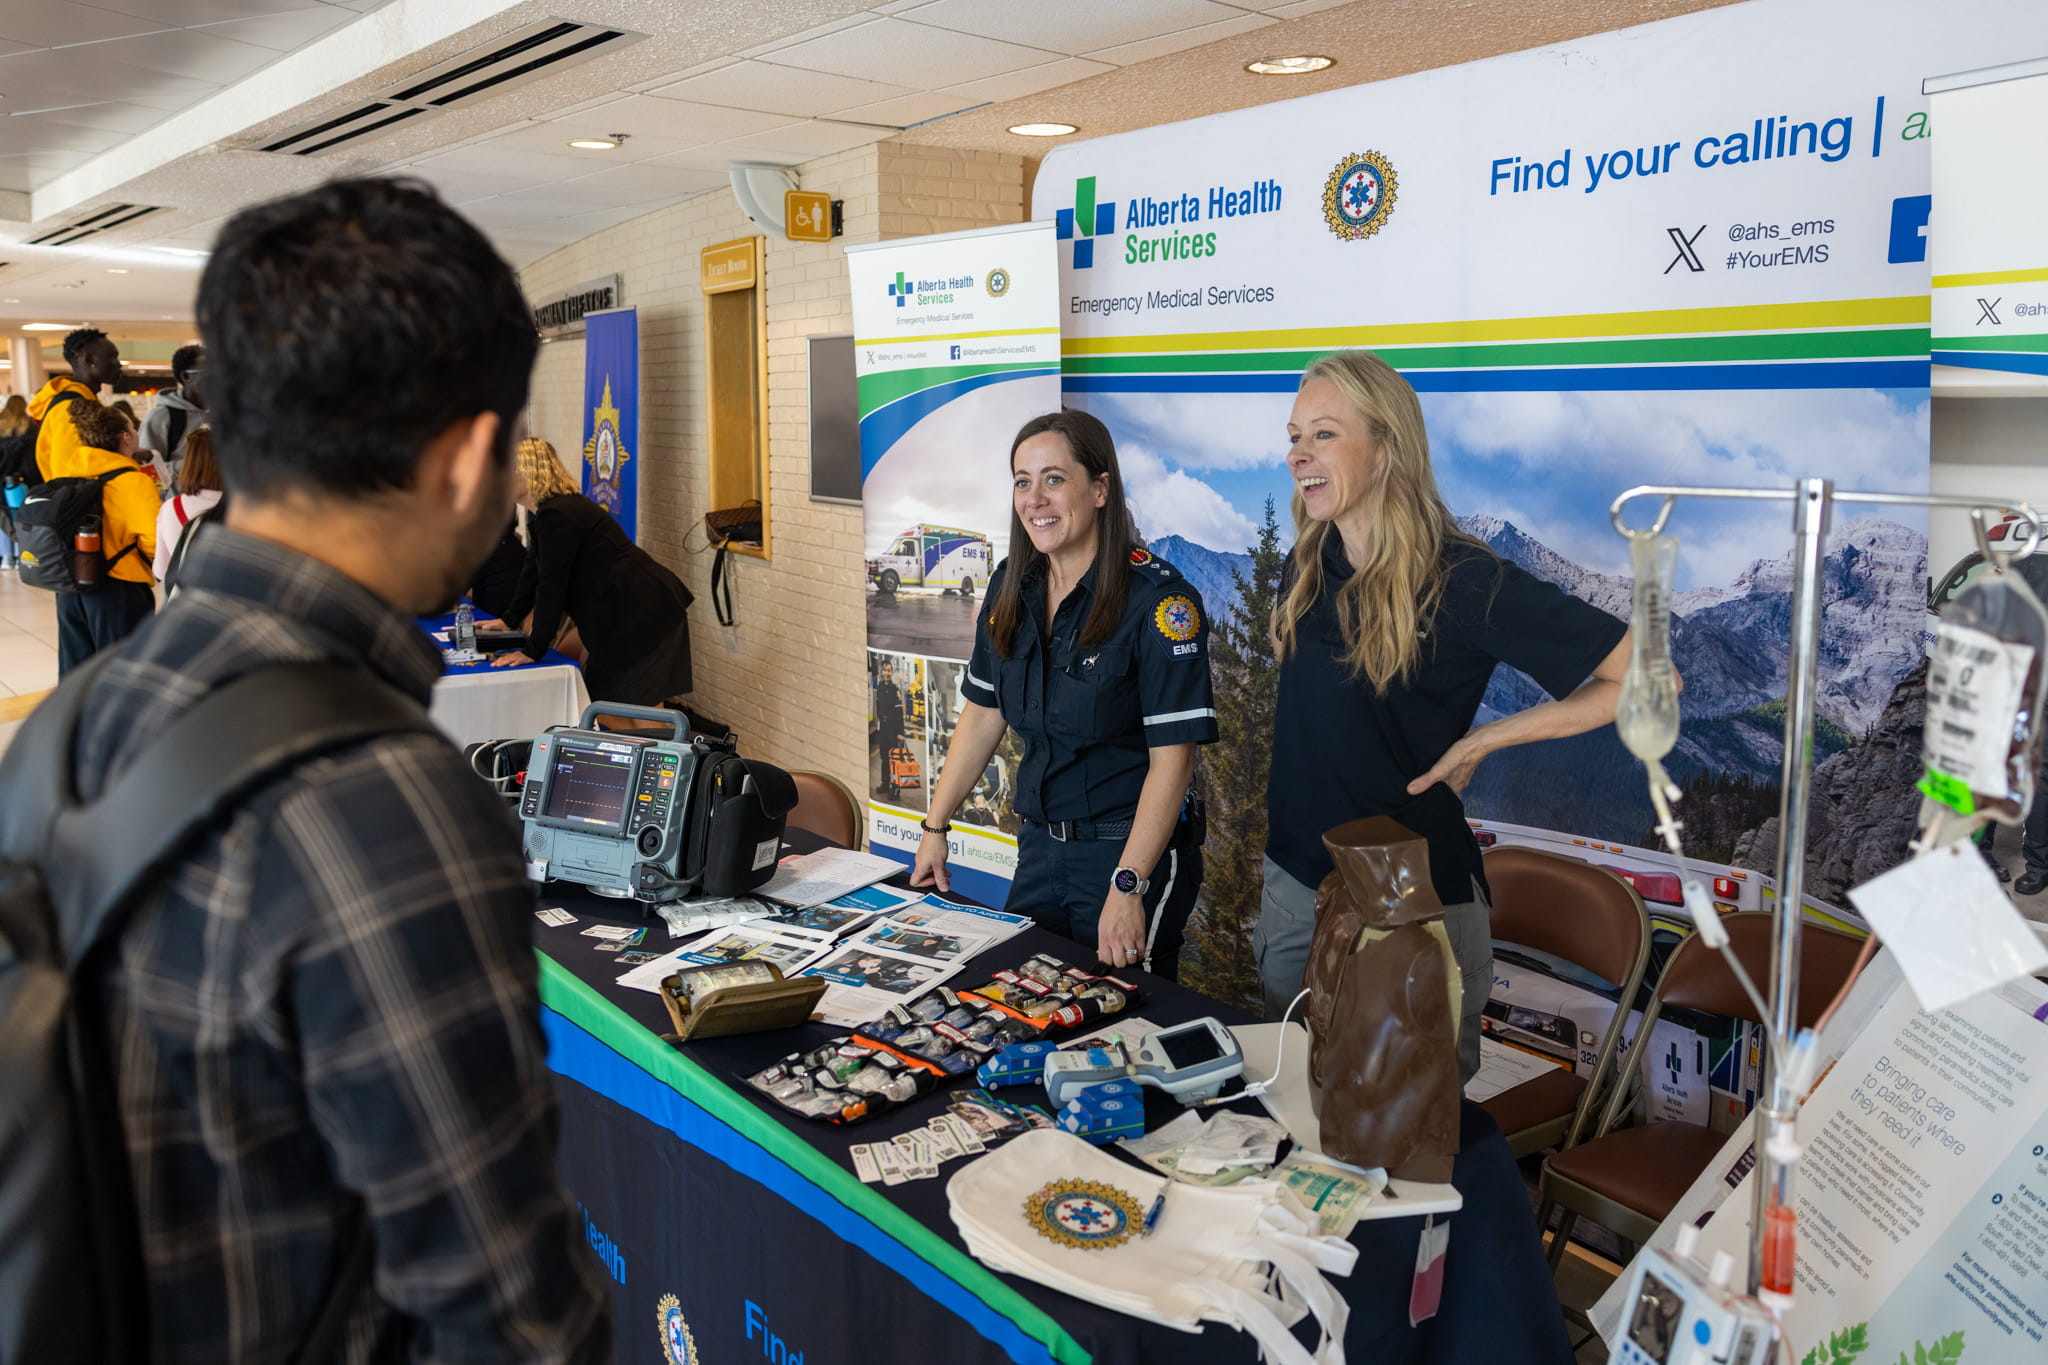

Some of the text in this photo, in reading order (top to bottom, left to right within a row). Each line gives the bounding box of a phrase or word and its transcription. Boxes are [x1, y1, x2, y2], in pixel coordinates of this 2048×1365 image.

[1490, 149, 1570, 196] Find
[1585, 141, 1681, 193] your
[1693, 114, 1853, 170] calling
[1126, 179, 1282, 229] Alberta Health
[1125, 231, 1216, 265] Services
[1728, 218, 1835, 242] @ahs_ems
[1726, 244, 1829, 270] #YourEMS
[917, 275, 974, 292] Alberta Health
[917, 293, 954, 306] Services
[1071, 285, 1274, 316] Emergency Medical Services
[962, 547, 977, 559] EMS
[1173, 643, 1198, 656] EMS
[877, 820, 897, 836] Find
[900, 830, 922, 841] your
[939, 903, 963, 911] HOW
[977, 911, 1009, 921] APPLY
[1892, 1037, 1903, 1047] to
[1899, 1042, 1931, 1068] patients
[1929, 1062, 1938, 1071] in
[1936, 1067, 1954, 1083] their
[1900, 1026, 1939, 1058] community
[1938, 1052, 1981, 1085] paramedics
[1977, 1079, 1999, 1099] bring
[1908, 1016, 1929, 1035] signs
[1927, 1029, 1944, 1044] and
[1941, 1038, 1977, 1066] providing
[1950, 1028, 1970, 1044] tests
[1968, 1040, 1978, 1050] to
[1871, 1054, 1957, 1123] Bringing care
[1847, 1087, 1923, 1148] they need it
[1861, 1071, 1968, 1157] to patients where
[1819, 1126, 1845, 1150] receiving
[1843, 1146, 1857, 1159] care
[1860, 1161, 1889, 1187] accessing
[1892, 1187, 1926, 1217] Community
[1841, 1129, 1853, 1140] For
[1867, 1151, 1879, 1162] the
[1876, 1159, 1899, 1180] biggest
[1914, 1190, 1923, 1198] to
[1851, 1122, 1867, 1138] need
[1864, 1134, 1879, 1148] care
[1877, 1144, 1885, 1152] at
[1883, 1150, 1900, 1165] some
[1898, 1162, 1915, 1178] point
[1913, 1174, 1921, 1182] in
[1919, 1179, 1930, 1190] our
[1805, 1158, 1828, 1179] patients
[1826, 1175, 1840, 1189] who
[1886, 1230, 1901, 1244] they
[1812, 1135, 1845, 1164] paramedics
[1843, 1160, 1859, 1175] work
[1895, 1205, 1908, 1218] and
[1906, 1215, 1921, 1228] care
[1822, 1157, 1831, 1166] to
[1829, 1163, 1846, 1179] break
[1871, 1200, 1886, 1213] and
[1881, 1209, 1899, 1226] bring
[1896, 1222, 1911, 1236] care
[2009, 1192, 2020, 1203] To
[1798, 1196, 1811, 1208] can
[1809, 1205, 1819, 1215] be
[1859, 1252, 1873, 1266] and
[1806, 1220, 1839, 1250] community
[2007, 1208, 2022, 1222] and
[2020, 1218, 2039, 1236] north
[2010, 1243, 2027, 1259] Red
[1951, 1262, 2043, 1342] community paramedics, visit
[1960, 1251, 2048, 1328] For more information about
